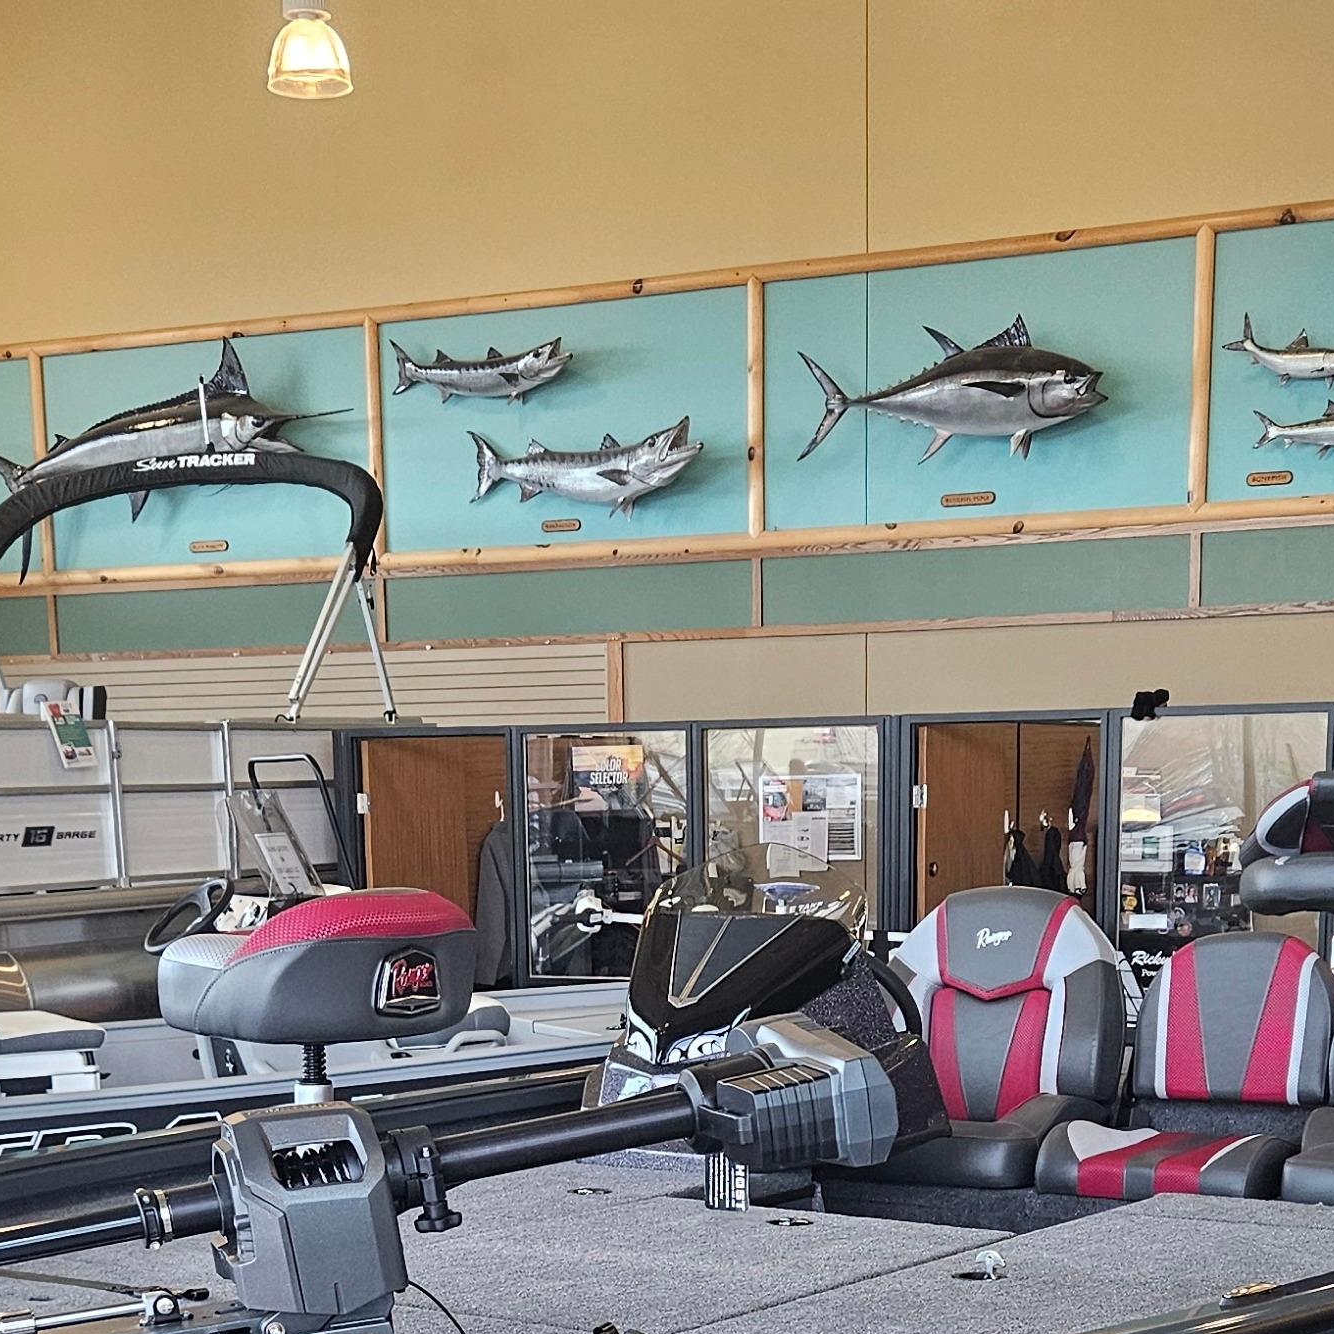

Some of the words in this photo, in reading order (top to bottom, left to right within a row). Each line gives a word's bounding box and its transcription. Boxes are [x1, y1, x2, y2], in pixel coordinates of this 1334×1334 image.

[176, 453, 256, 468] TRACKER
[589, 771, 628, 785] SELECTOR
[56, 830, 97, 839] BARGE
[735, 1164, 746, 1211] HOST
